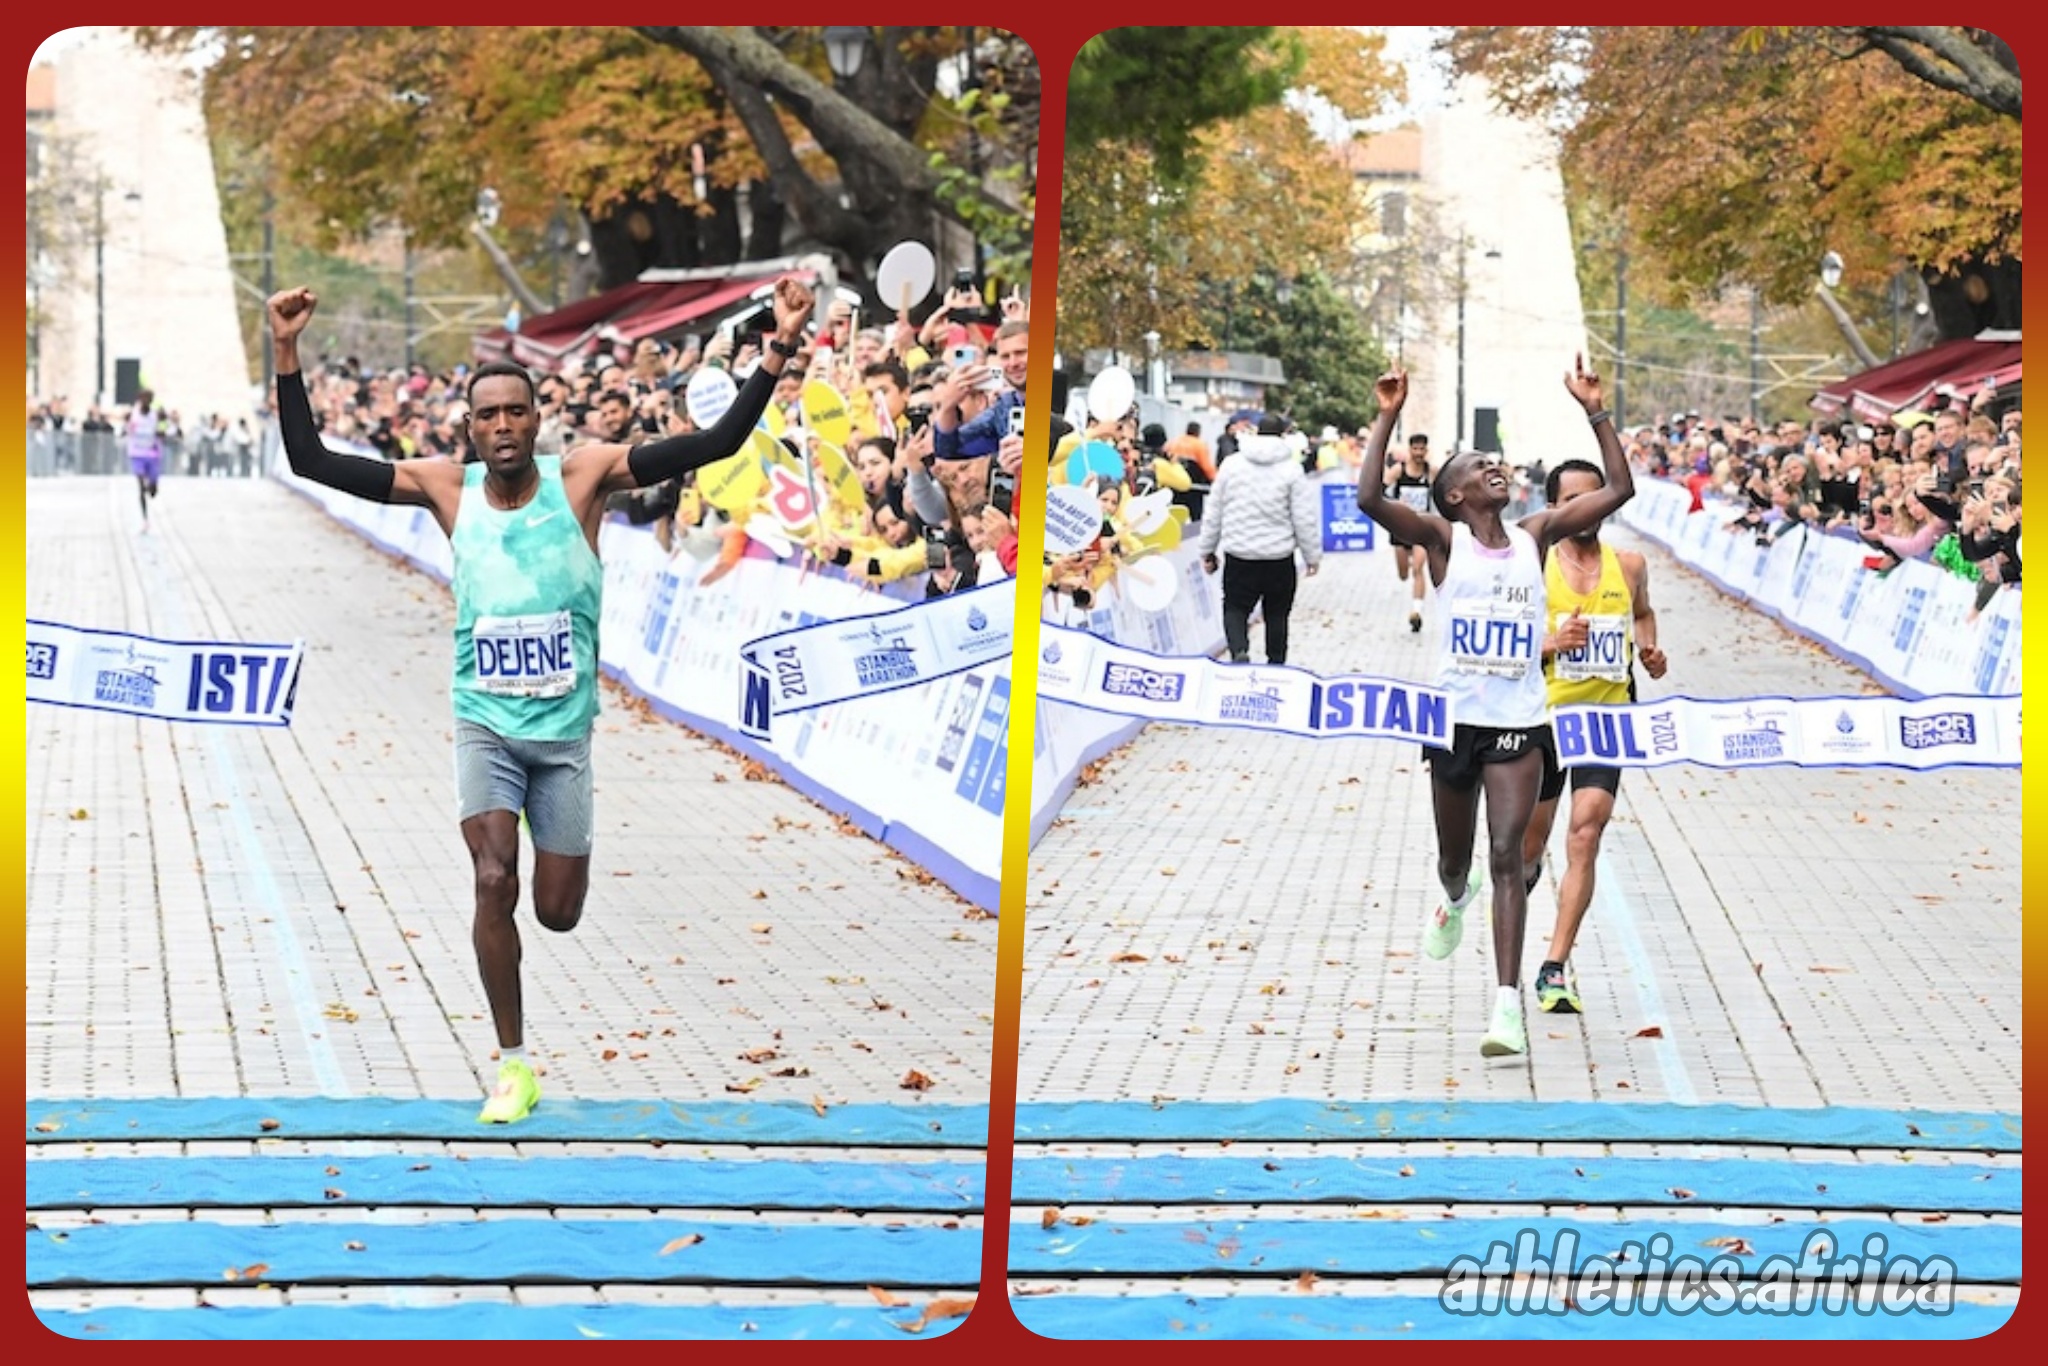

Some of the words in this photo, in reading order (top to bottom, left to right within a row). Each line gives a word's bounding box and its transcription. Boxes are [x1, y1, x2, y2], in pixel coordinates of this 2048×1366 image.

[476, 632, 572, 676] DEJENE
[1452, 618, 1534, 658] RUTH
[774, 645, 807, 699] 2024
[1108, 665, 1178, 690] SPOR
[1308, 682, 1447, 738] ISTAN
[1904, 714, 1968, 734] SPOR
[1556, 711, 1647, 760] BUL
[1650, 711, 1678, 755] 2024
